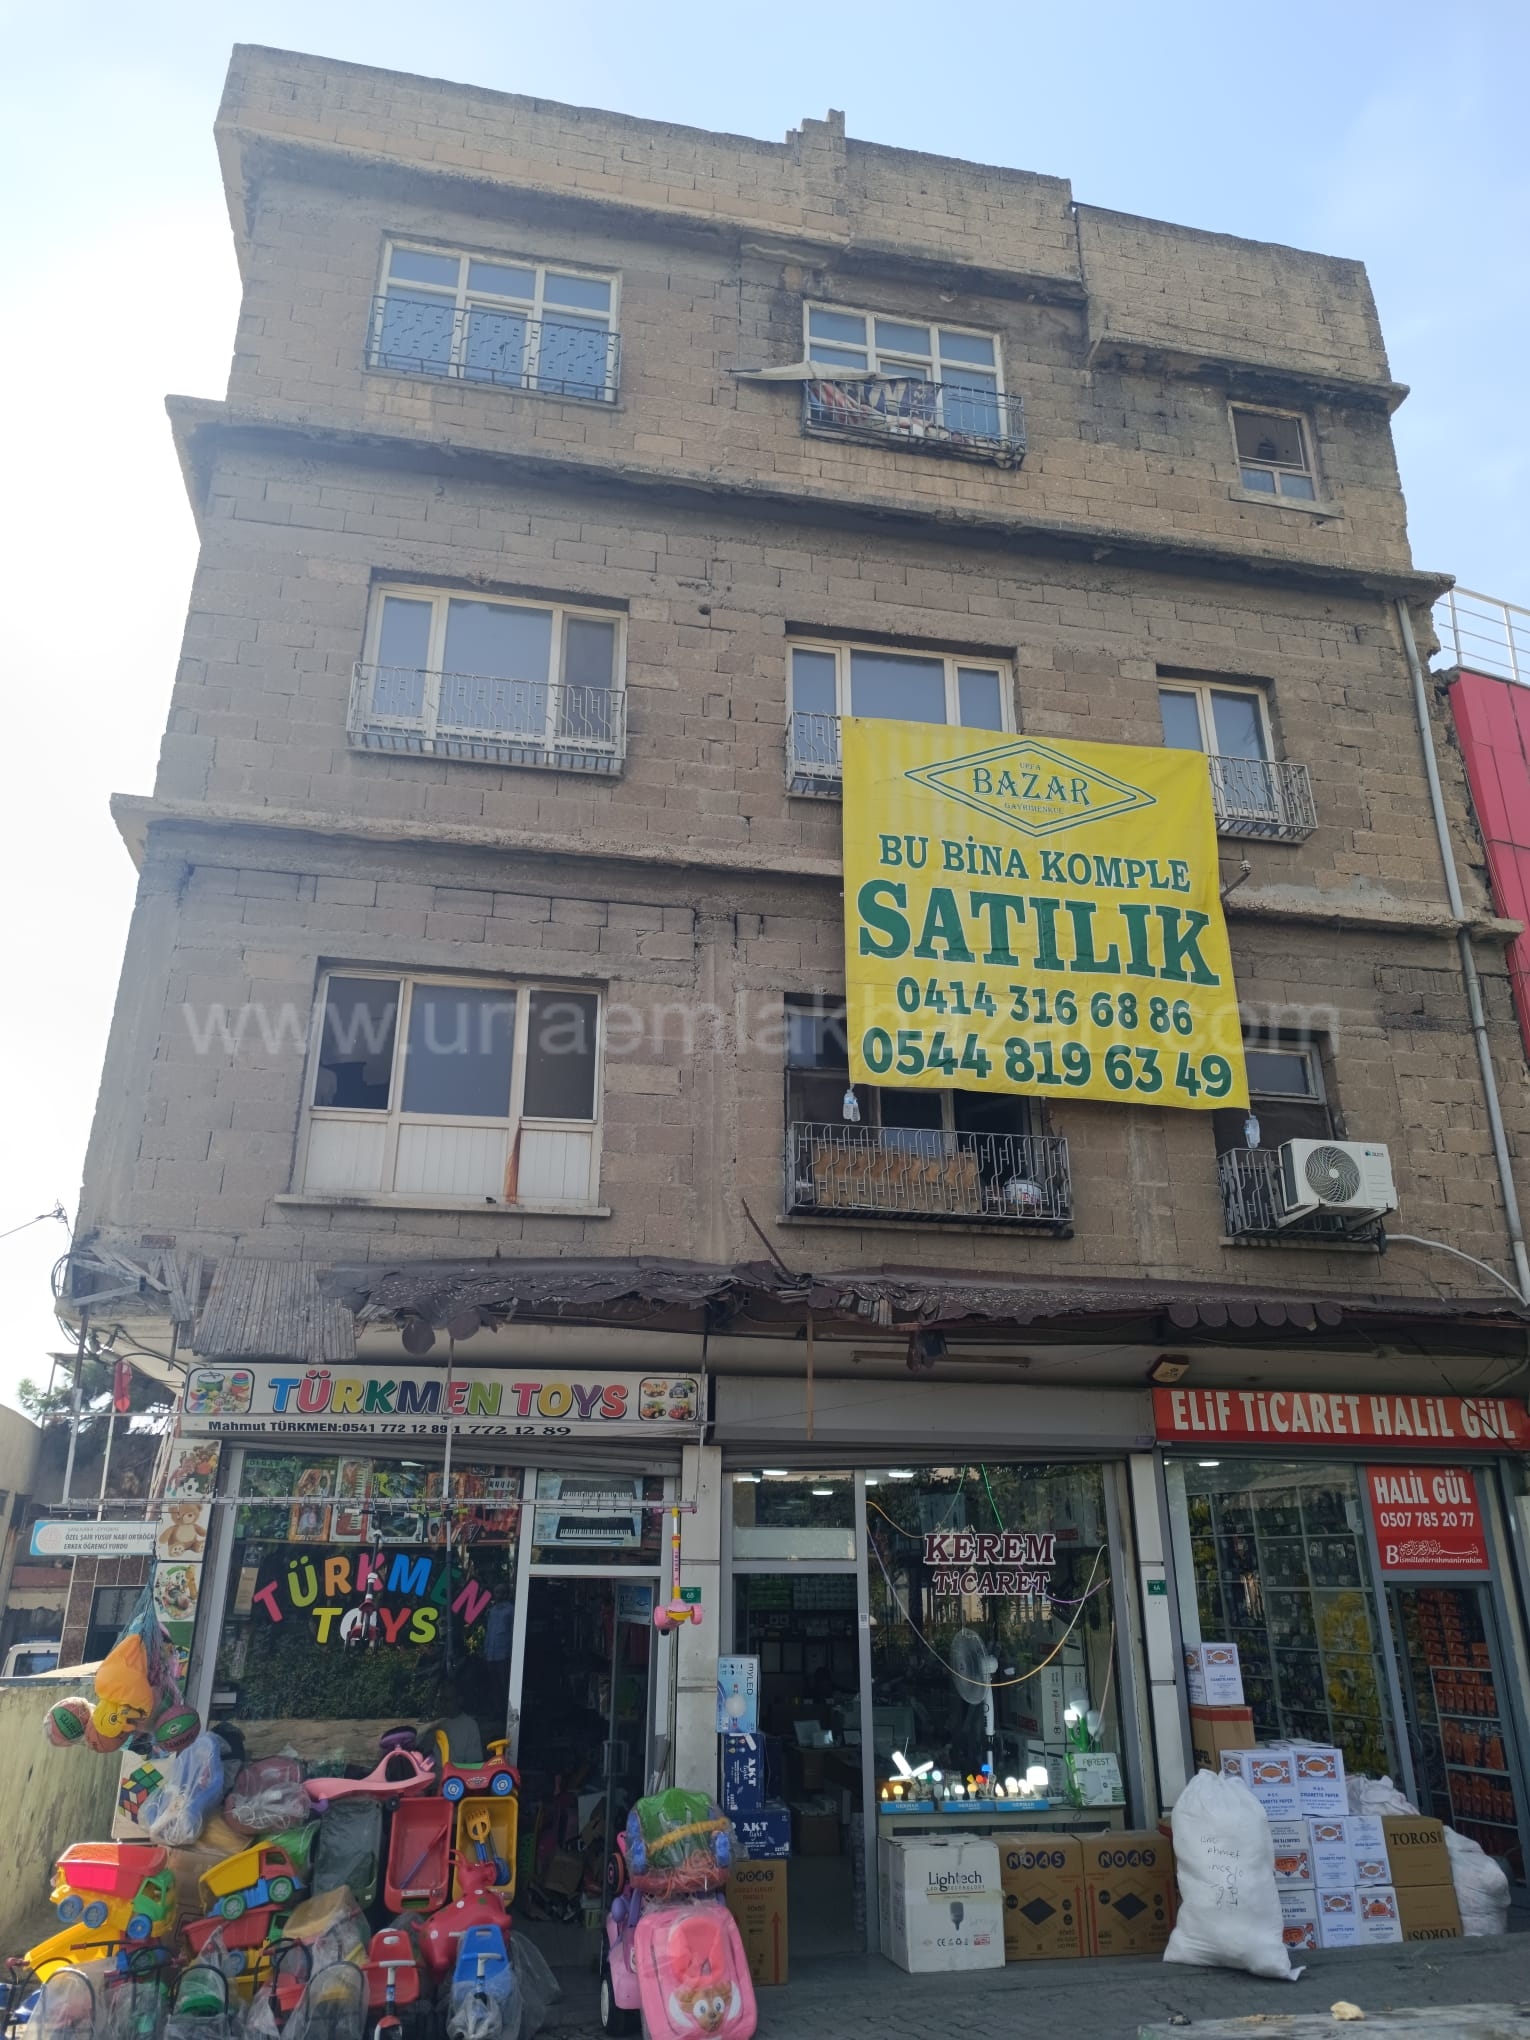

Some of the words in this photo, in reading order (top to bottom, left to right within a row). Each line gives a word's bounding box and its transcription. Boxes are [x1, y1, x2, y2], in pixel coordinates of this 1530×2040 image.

[973, 767, 1091, 807] BAZAR
[879, 833, 929, 868] BU
[941, 835, 1029, 880] BİNA
[1040, 850, 1191, 893] KOMPLE
[857, 879, 1220, 987] SATILIK
[896, 976, 997, 1017] 0414
[1009, 985, 1078, 1025] 316
[1090, 992, 1139, 1030] 68
[1149, 996, 1193, 1036] 86
[862, 1026, 992, 1079] 0544
[1004, 1036, 1092, 1087] 819
[1104, 1044, 1163, 1094] 63
[1175, 1052, 1233, 1098] 49
[267, 1369, 504, 1417] TÜRKMEN
[511, 1381, 628, 1418] TOYS
[208, 1421, 266, 1433] Mahmut
[381, 1424, 406, 1433] 772
[411, 1424, 427, 1434] 12
[431, 1424, 448, 1434] 89
[468, 1425, 508, 1435] 772
[515, 1426, 536, 1435] 12
[542, 1426, 571, 1436] 89
[1373, 1470, 1429, 1504] HALİL
[1432, 1469, 1472, 1504] GÜL
[1380, 1511, 1413, 1527] 0507
[1415, 1511, 1439, 1527] 785
[1442, 1511, 1459, 1527] 20
[1460, 1511, 1475, 1527] 77
[923, 1532, 1056, 1565] KEREM
[742, 1822, 769, 1832] AKT
[1389, 1831, 1438, 1846] TOROS
[1006, 1850, 1066, 1870] NOAS
[1098, 1849, 1157, 1868] NOAS
[928, 1870, 982, 1892] Lightech
